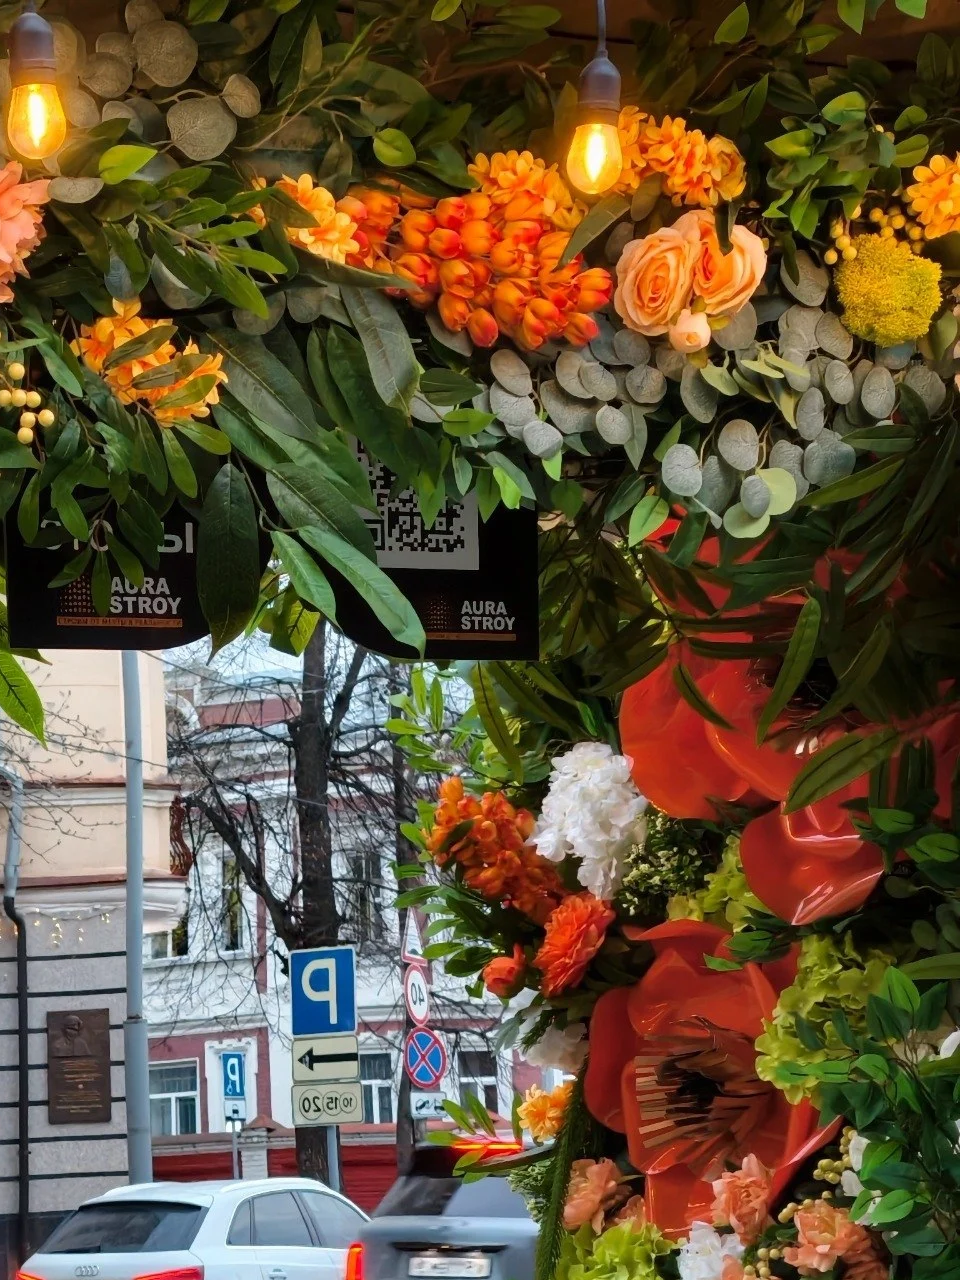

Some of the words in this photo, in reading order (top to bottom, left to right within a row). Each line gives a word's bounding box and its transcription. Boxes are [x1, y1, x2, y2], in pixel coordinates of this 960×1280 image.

[110, 576, 171, 595] AURA
[109, 596, 182, 615] STROY
[460, 600, 508, 615] AURA
[460, 616, 516, 631] STROY
